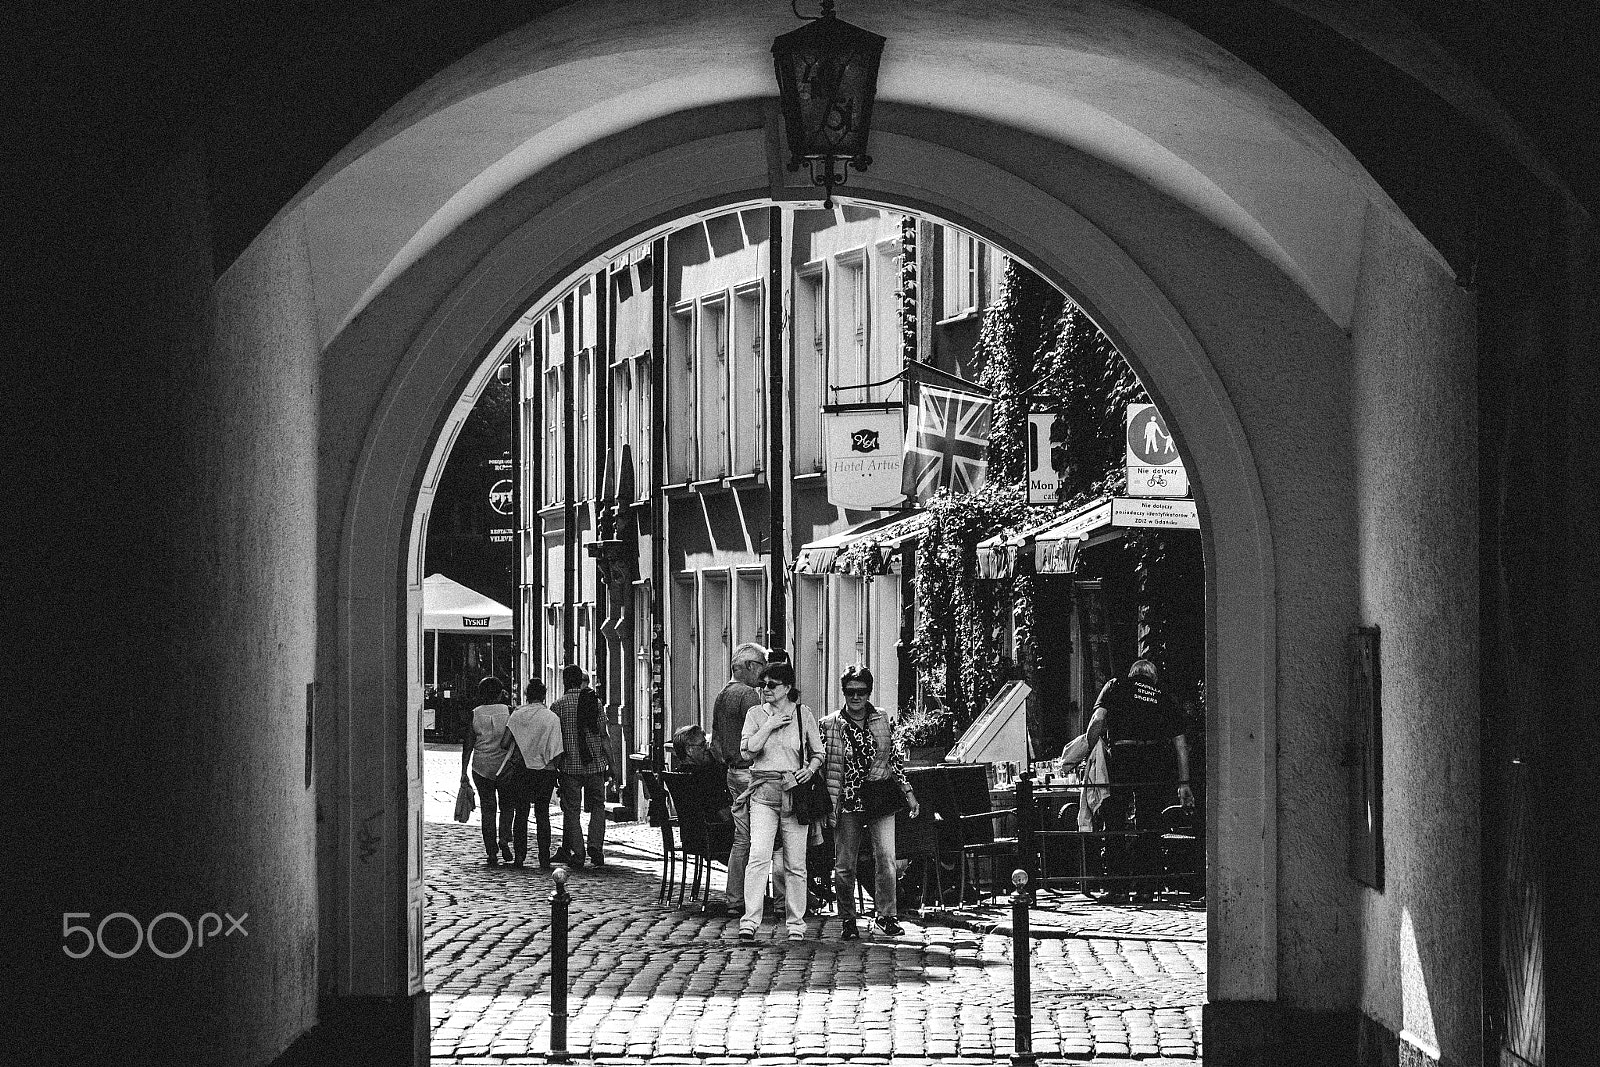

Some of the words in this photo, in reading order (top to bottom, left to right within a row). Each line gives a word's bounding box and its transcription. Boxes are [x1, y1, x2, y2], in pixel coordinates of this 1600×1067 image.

[834, 460, 865, 473] Hotel
[867, 459, 900, 471] Artus
[1030, 480, 1054, 490] Mon
[464, 618, 489, 626] TYSKIE
